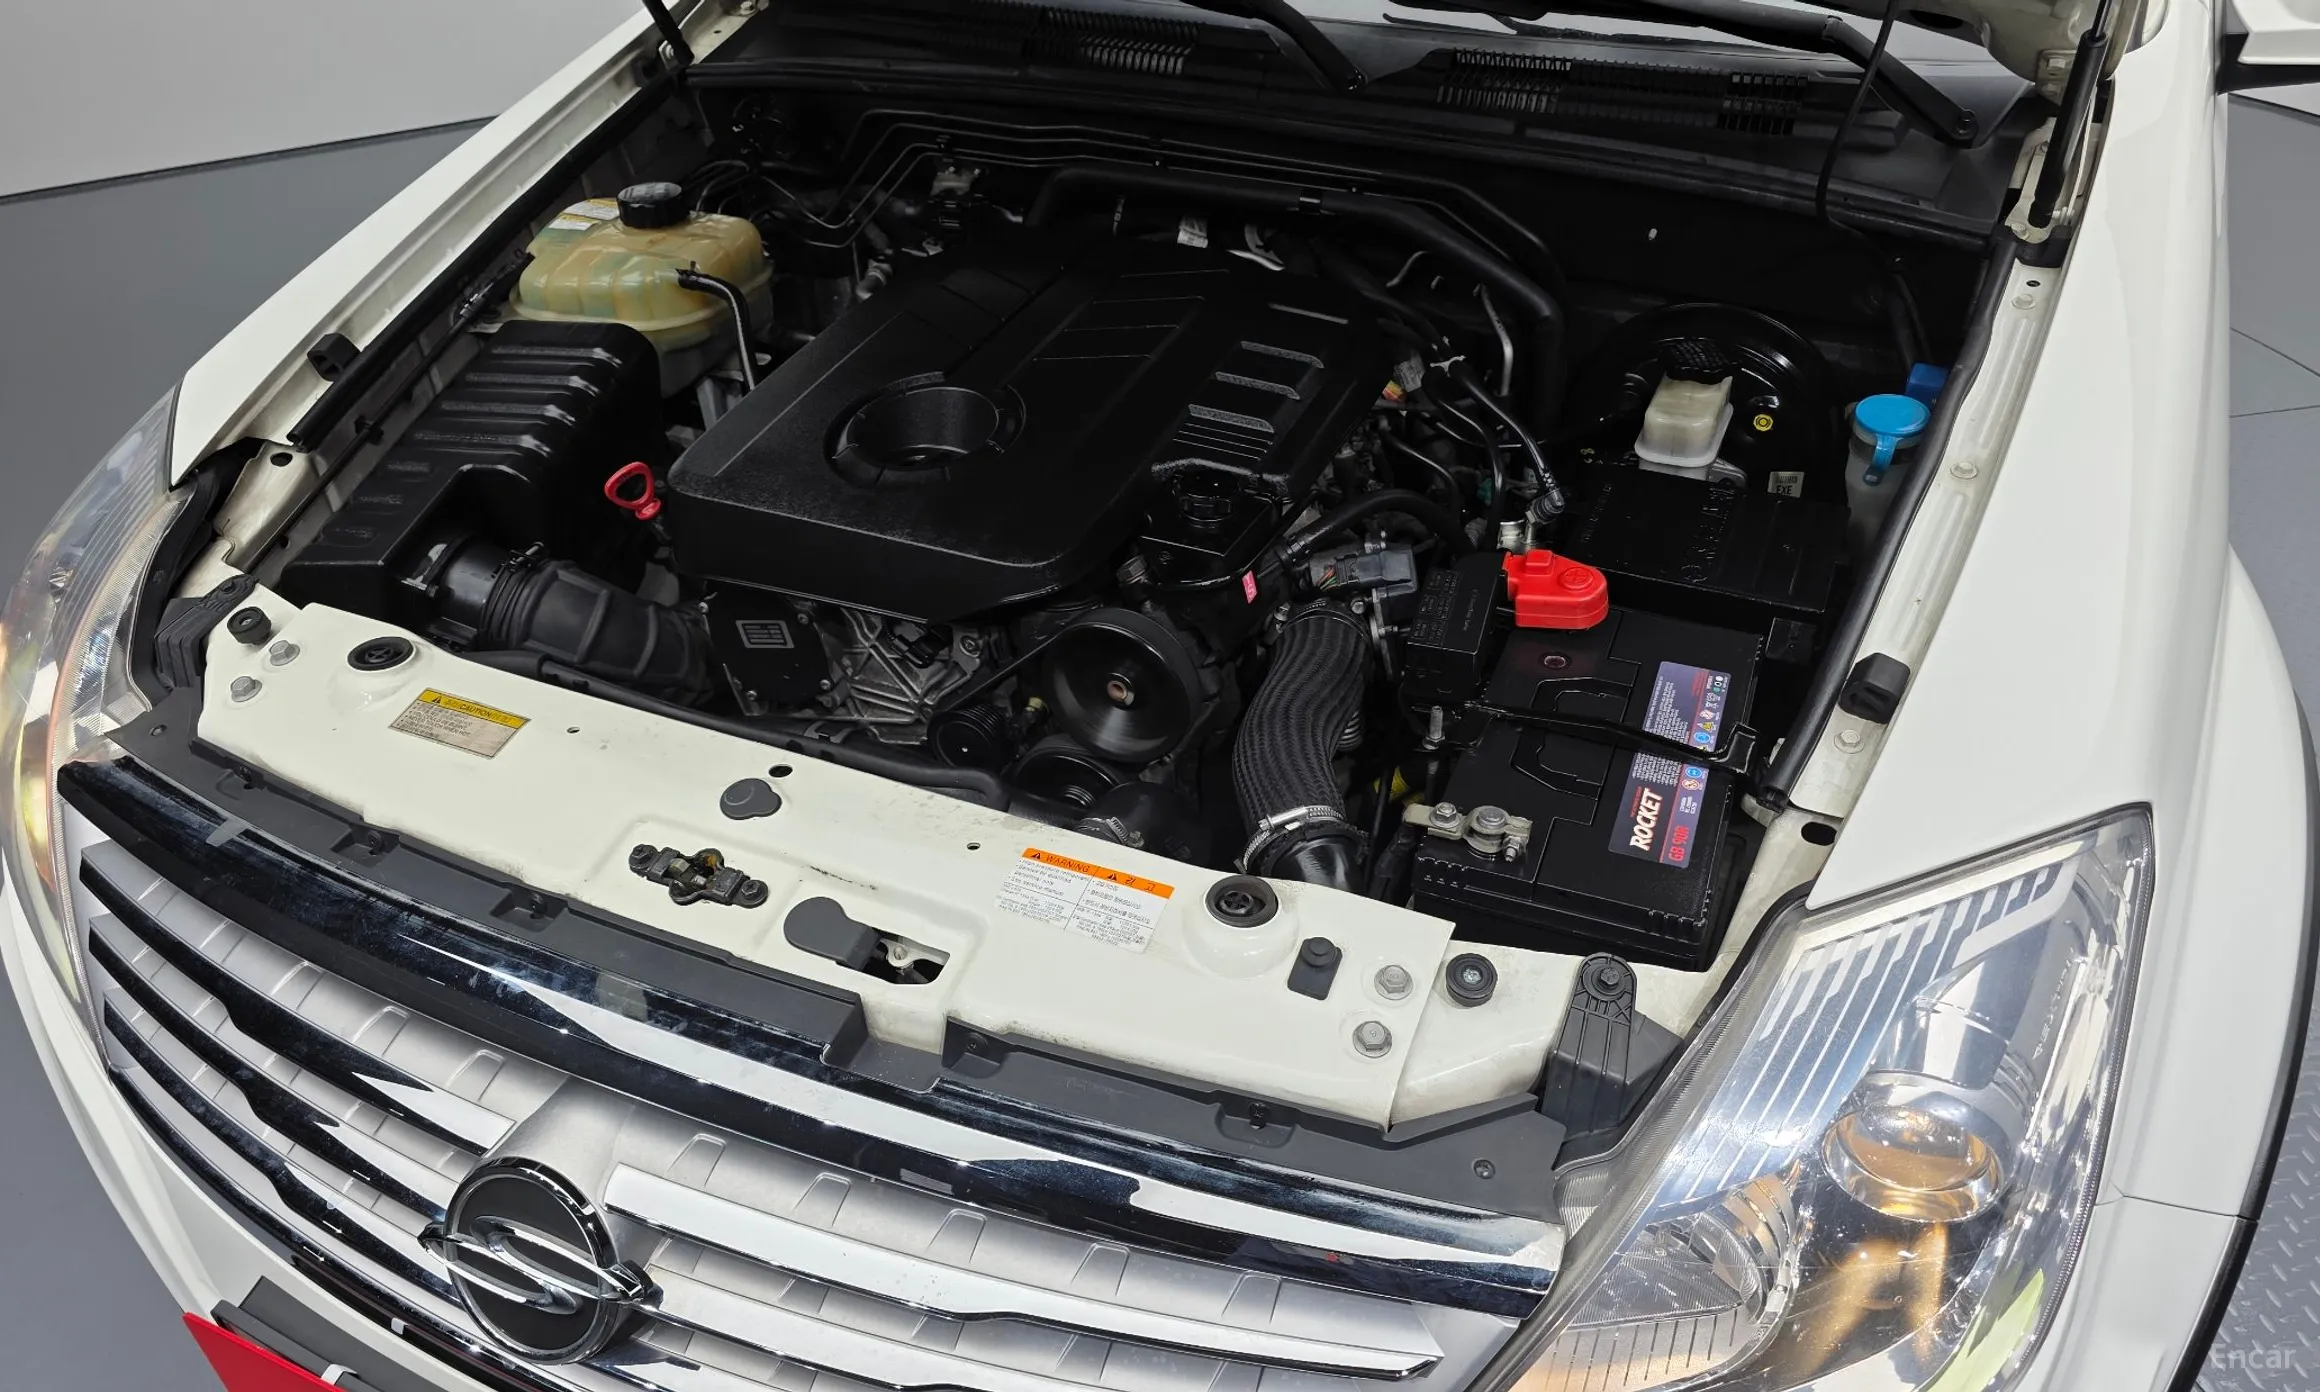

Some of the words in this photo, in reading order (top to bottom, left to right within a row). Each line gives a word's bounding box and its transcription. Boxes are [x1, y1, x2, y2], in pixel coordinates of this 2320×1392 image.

[459, 703, 491, 717] CAUTION
[1629, 787, 1663, 852] ROCKET
[1668, 845, 1685, 862] GB
[1046, 854, 1090, 873] WARNING
